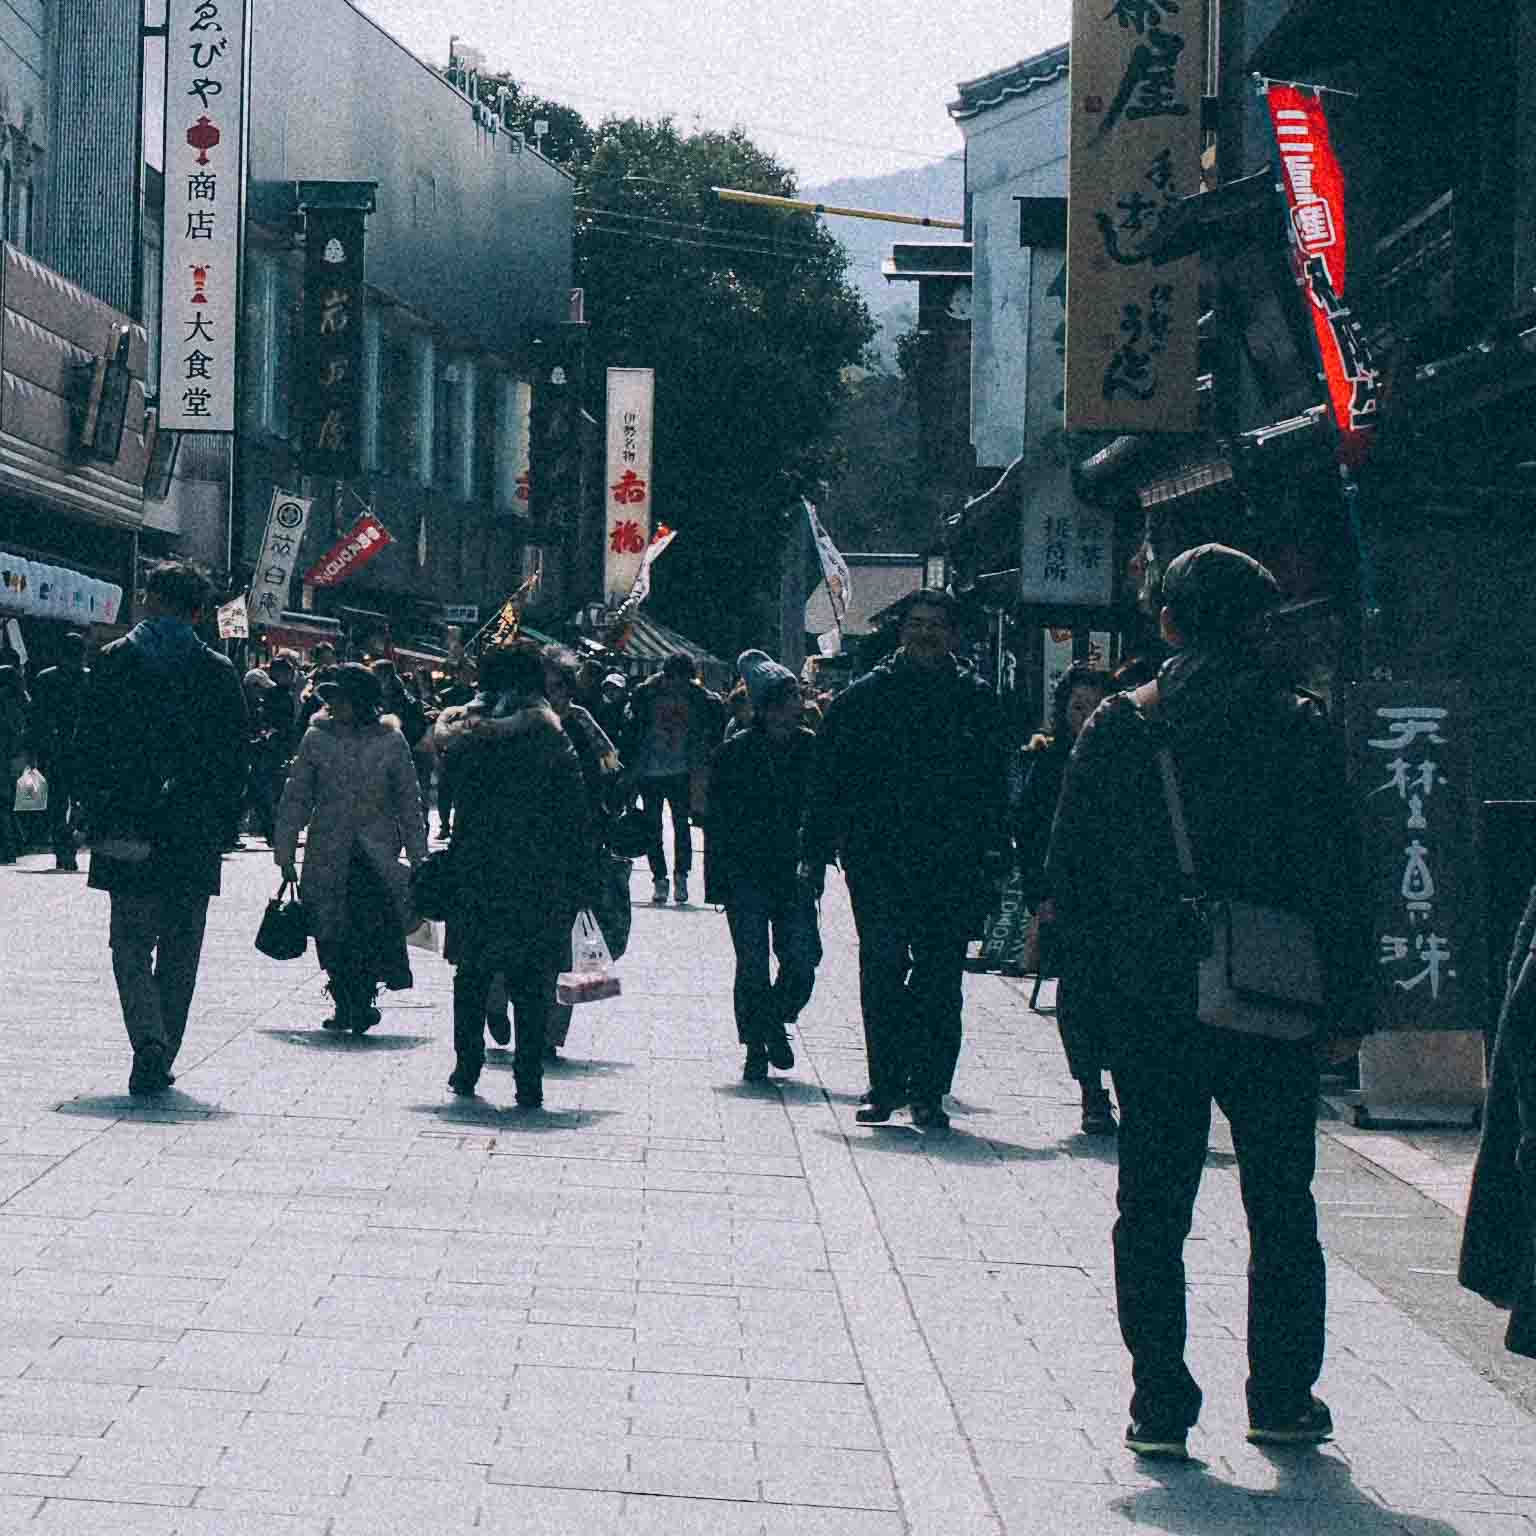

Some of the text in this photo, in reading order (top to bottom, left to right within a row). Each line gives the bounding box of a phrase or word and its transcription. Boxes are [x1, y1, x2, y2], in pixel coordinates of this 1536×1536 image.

[184, 170, 217, 241] 商店
[181, 312, 215, 417] 大食堂
[623, 412, 636, 463] 伊勢名物
[610, 469, 646, 554] 赤福
